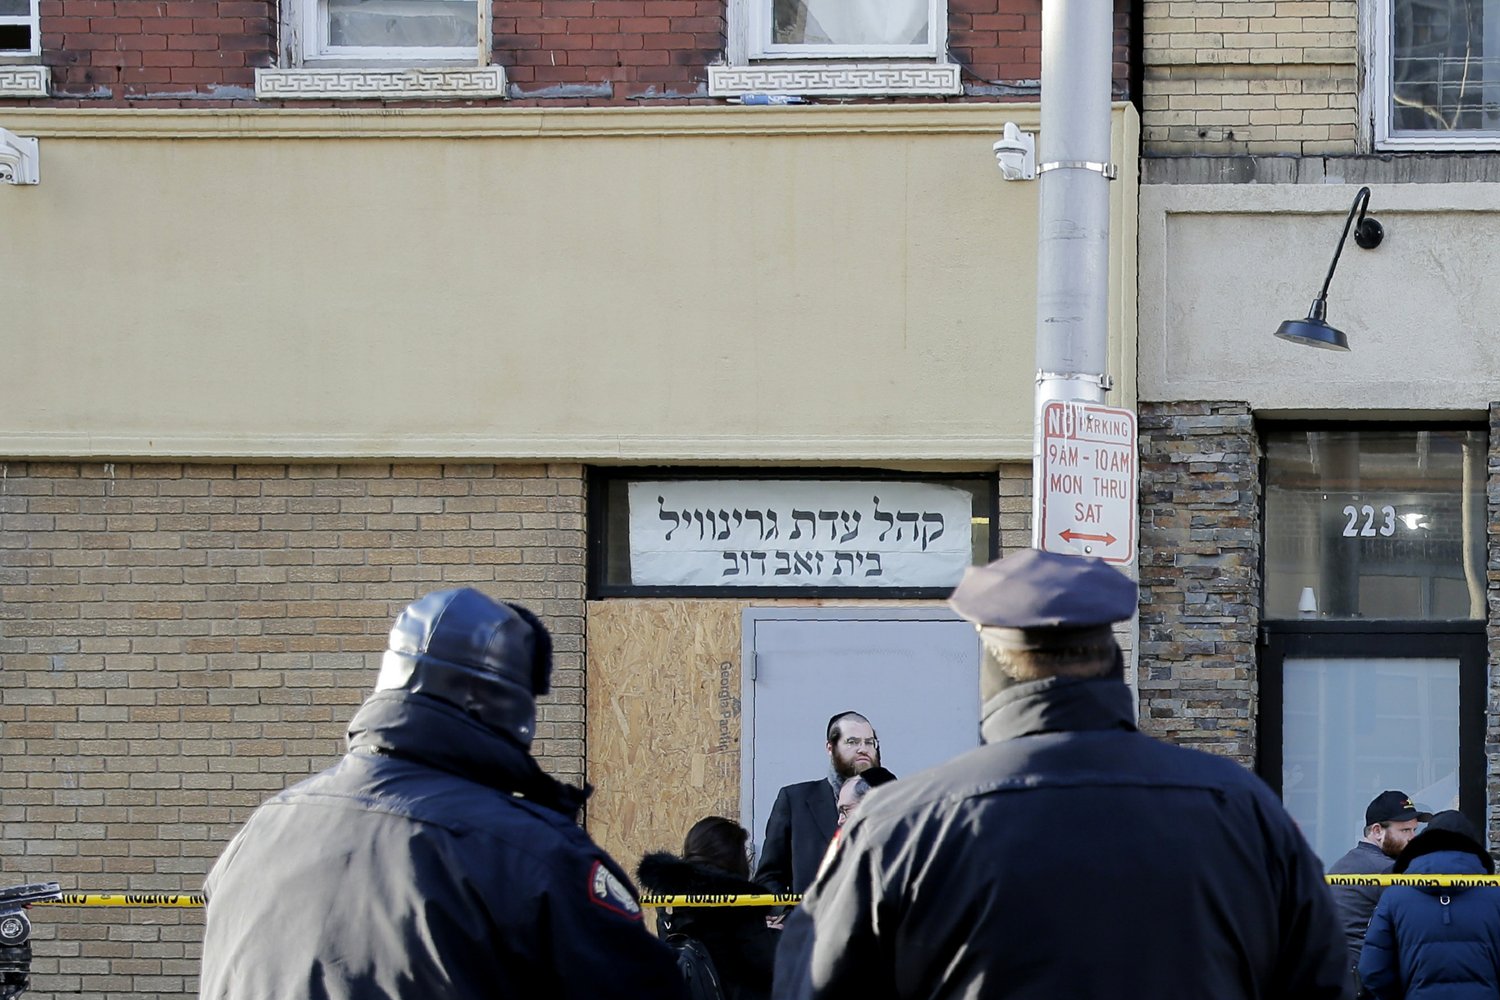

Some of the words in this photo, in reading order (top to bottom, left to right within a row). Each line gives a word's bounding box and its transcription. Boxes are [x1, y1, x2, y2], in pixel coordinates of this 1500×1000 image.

[1049, 407, 1074, 437] NO
[1049, 444, 1078, 467] 9AM
[1095, 448, 1129, 474] 10AM
[1050, 473, 1082, 495] MON
[1093, 477, 1127, 499] THRU
[658, 496, 779, 542] גרינוויל
[789, 507, 862, 544] עדת
[873, 496, 944, 551] קהל
[1075, 502, 1103, 523] SAT
[1342, 505, 1396, 537] 223
[722, 551, 767, 577] דוב
[774, 550, 824, 577] זאב
[832, 551, 883, 577] בית
